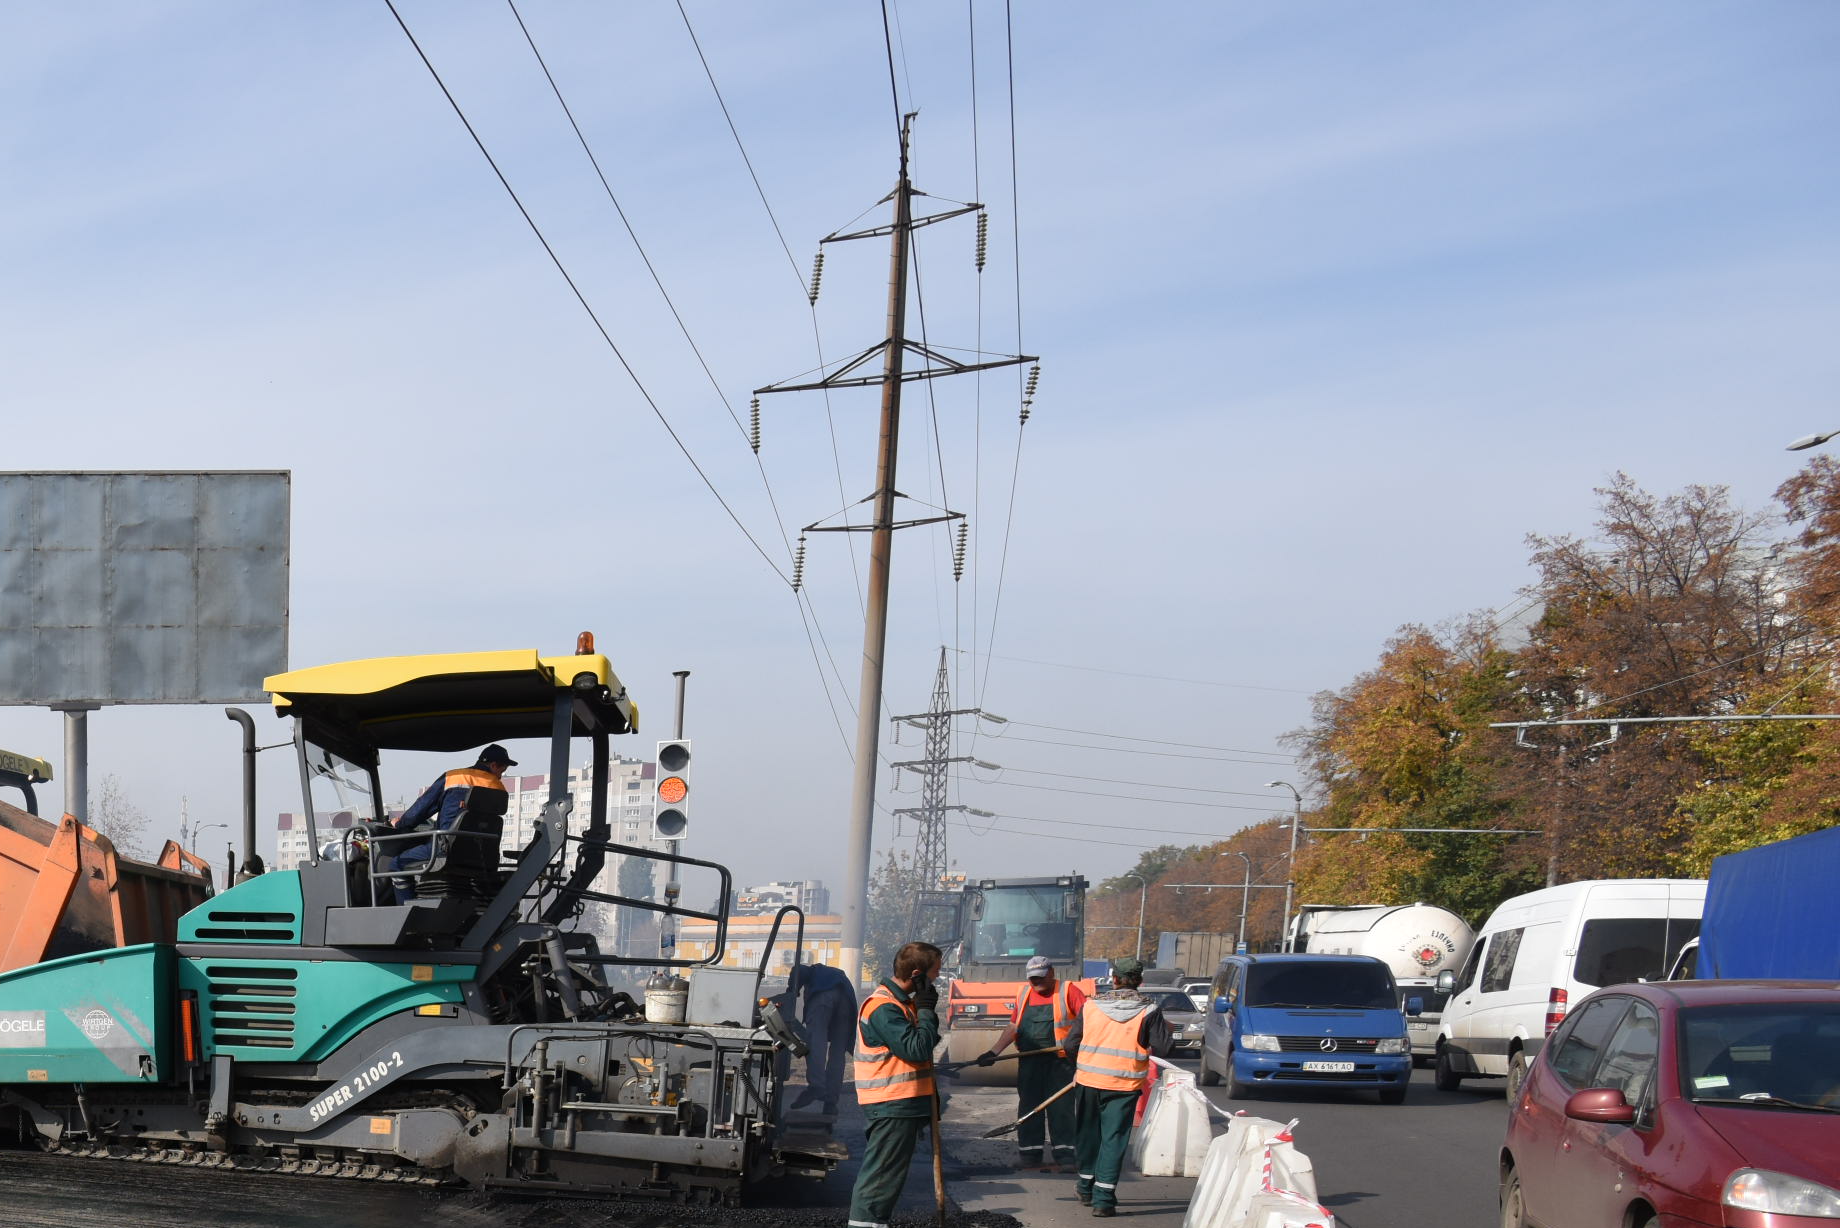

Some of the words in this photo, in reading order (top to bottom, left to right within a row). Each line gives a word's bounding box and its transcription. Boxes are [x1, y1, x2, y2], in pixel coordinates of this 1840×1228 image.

[1308, 1062, 1319, 1070] AX
[1320, 1062, 1338, 1070] 6161
[1341, 1062, 1352, 1070] AO
[309, 1085, 354, 1122] SUPER
[353, 1051, 404, 1093] 2100-2
